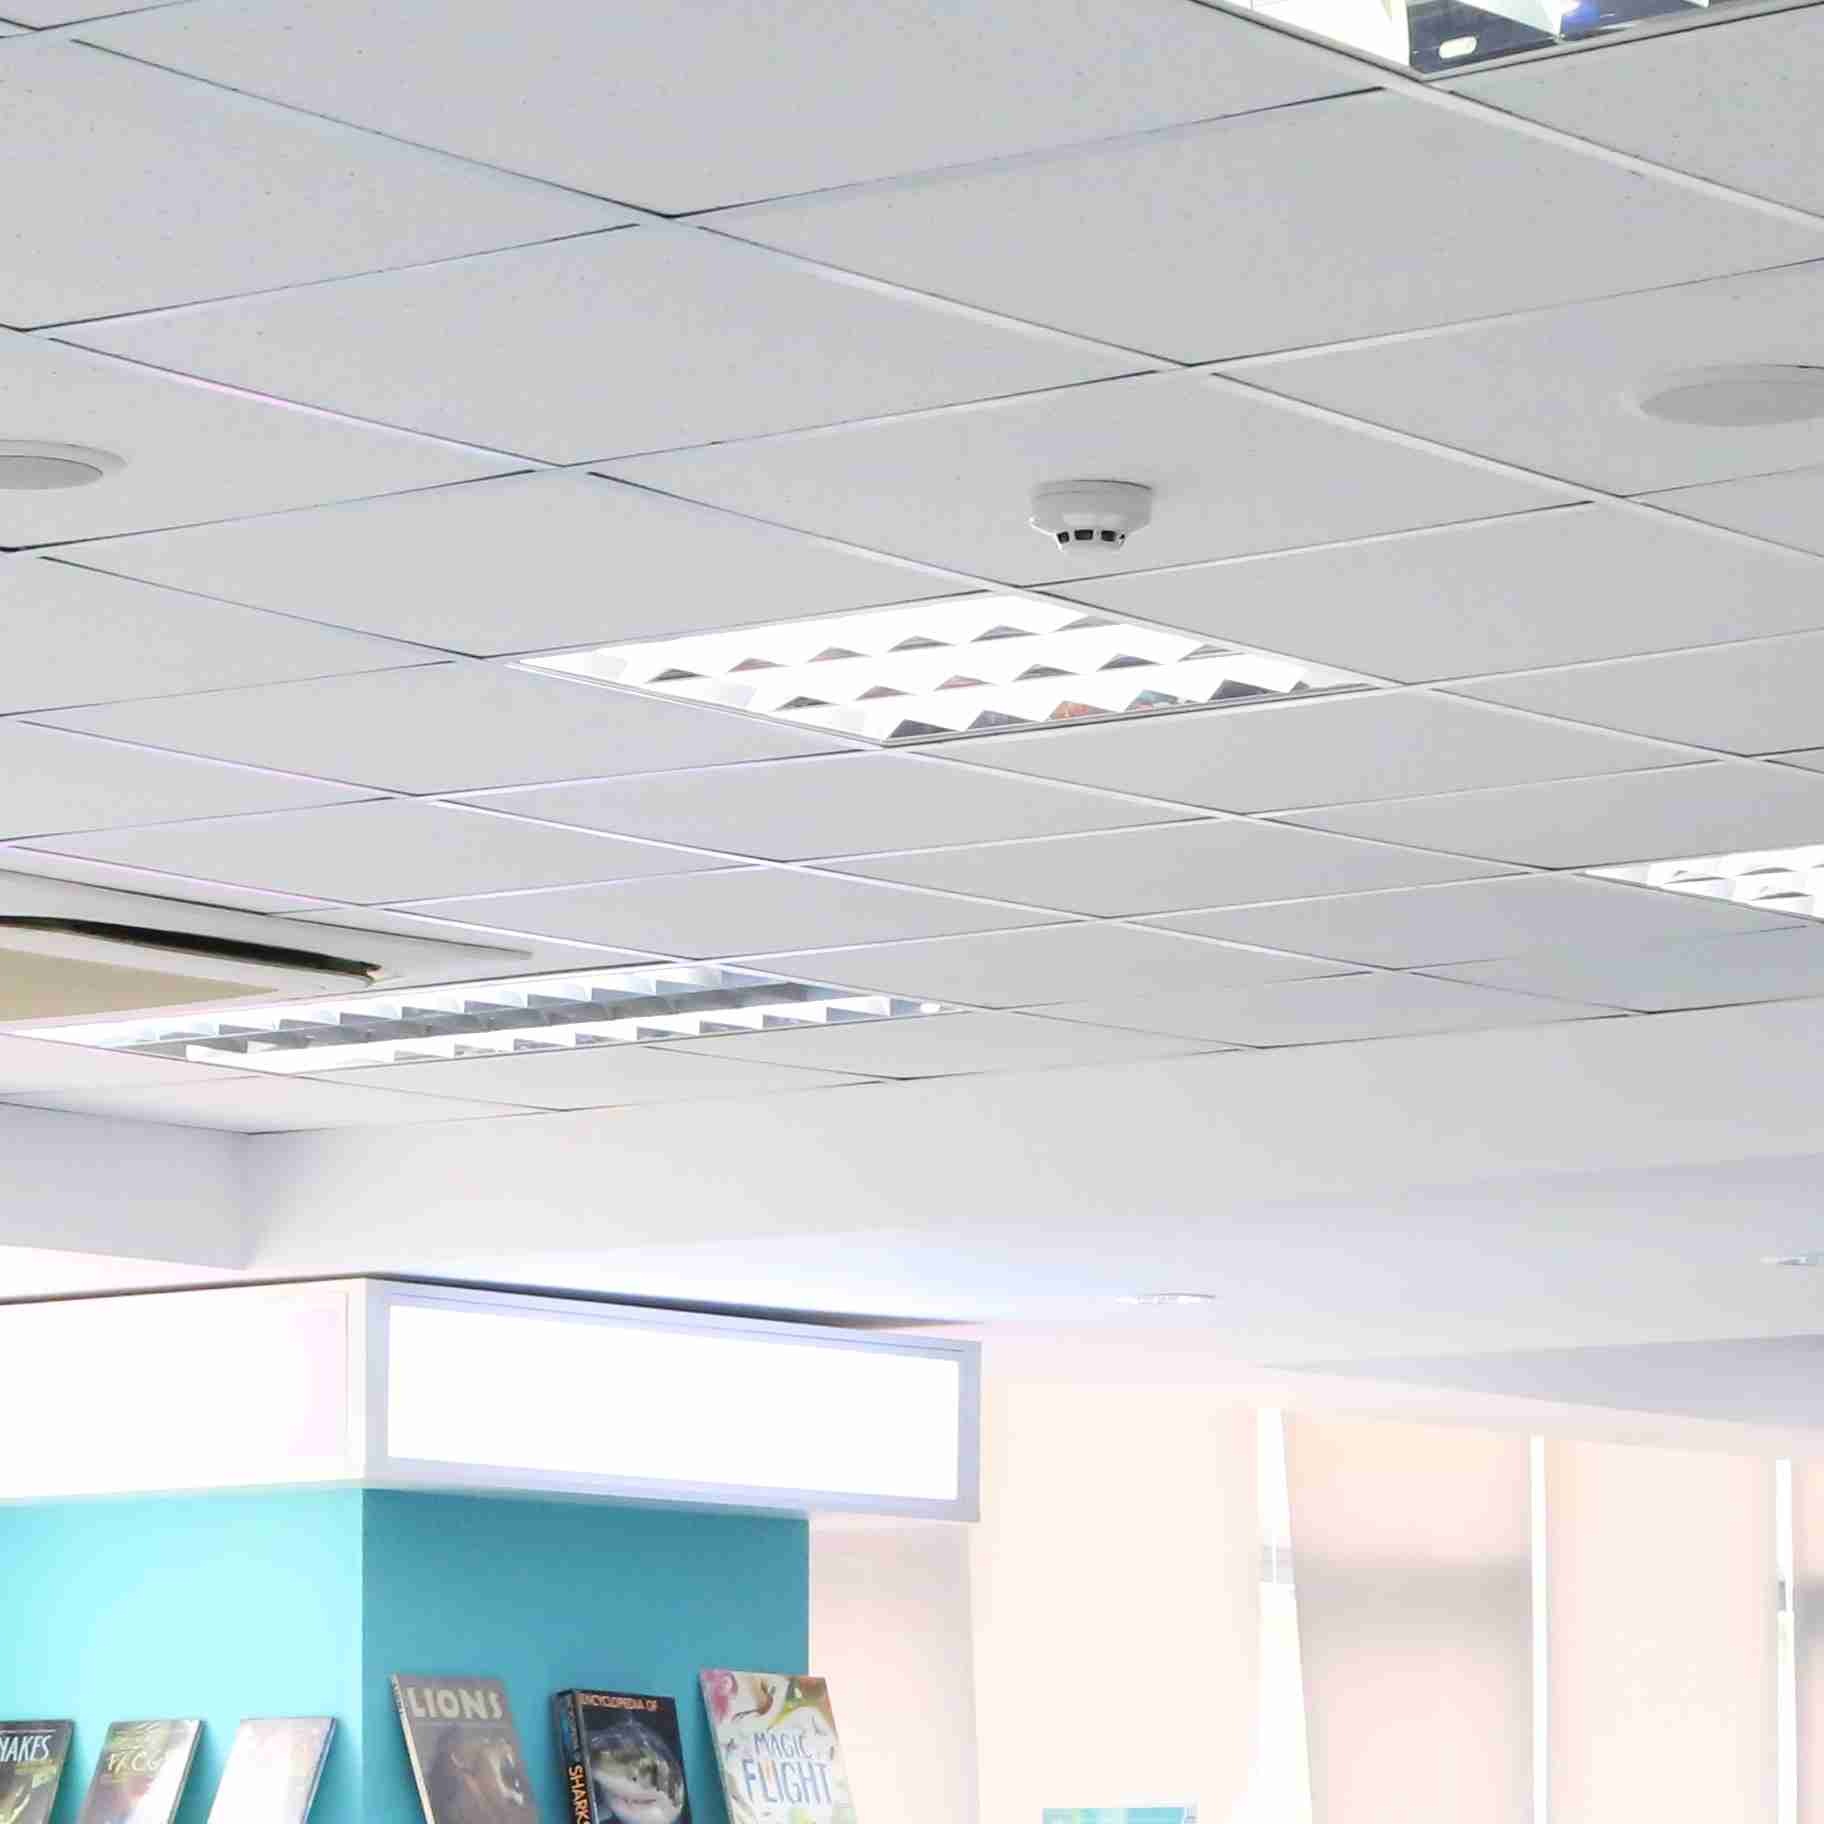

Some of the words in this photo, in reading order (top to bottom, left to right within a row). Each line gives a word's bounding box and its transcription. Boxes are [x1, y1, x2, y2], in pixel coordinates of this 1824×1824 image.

[405, 1687, 504, 1720] LIONS
[753, 1732, 815, 1760] MAGIC
[742, 1759, 833, 1805] FLIGHT
